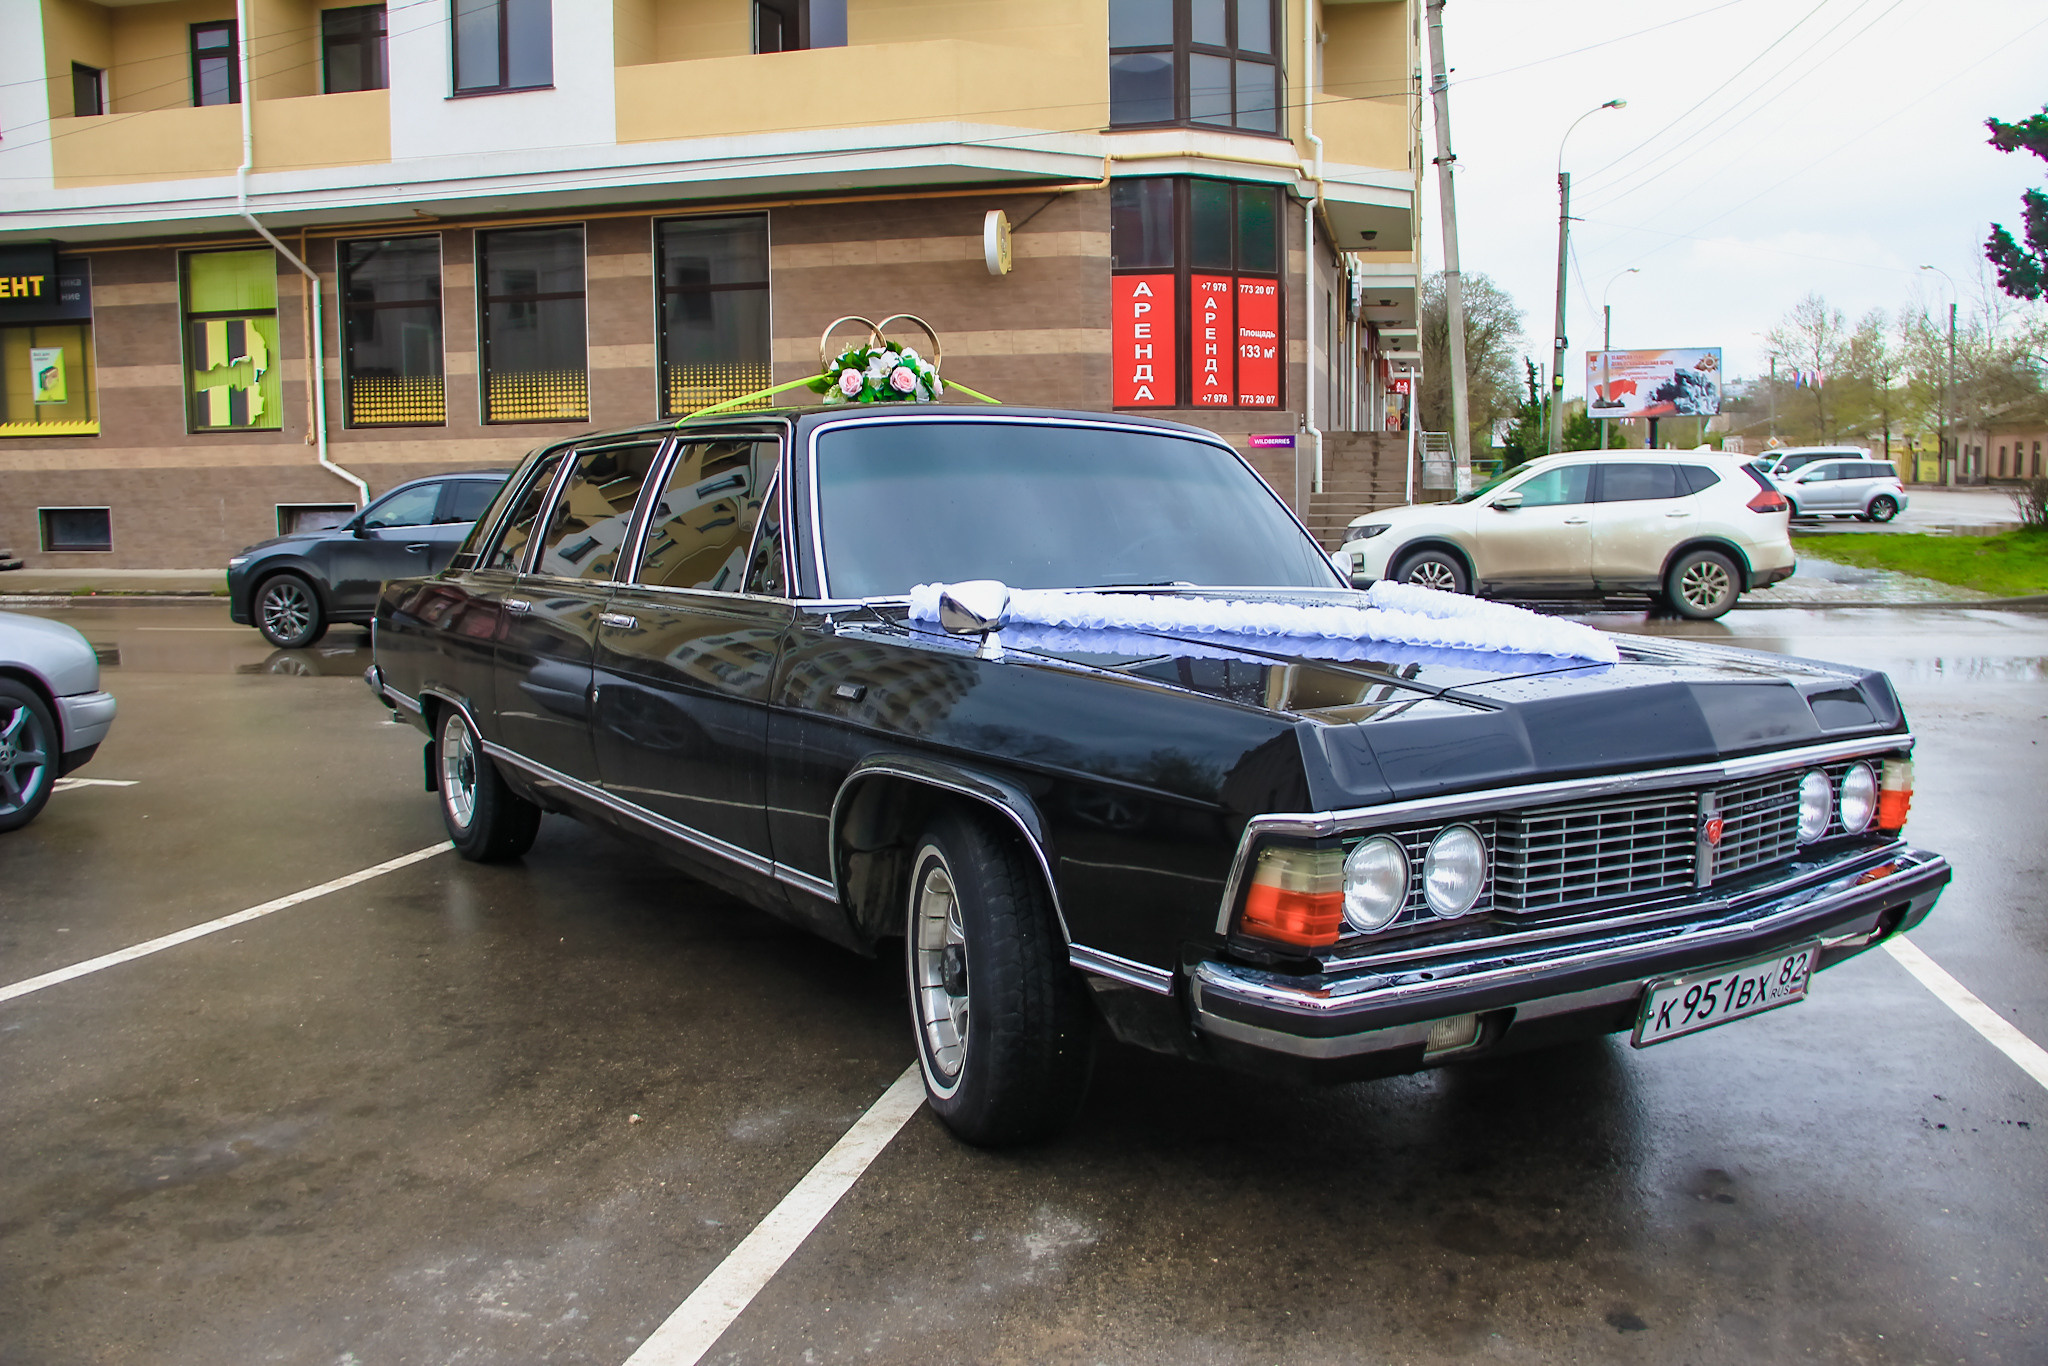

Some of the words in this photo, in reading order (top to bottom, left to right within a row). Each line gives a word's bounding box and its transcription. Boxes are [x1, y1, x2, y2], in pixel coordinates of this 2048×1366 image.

[1201, 282, 1211, 291] +7
[1212, 283, 1227, 292] 978
[1240, 284, 1254, 294] 773
[1255, 286, 1264, 295] 20
[1265, 286, 1275, 295] 07
[1240, 327, 1276, 339] Площадь
[1132, 281, 1155, 401] АРЕНДА
[1204, 297, 1218, 386] АРЕНДА
[1240, 344, 1261, 358] 133
[1202, 394, 1212, 403] +7
[1213, 394, 1228, 403] 978
[1240, 394, 1254, 404] 773
[1255, 395, 1265, 404] 20
[1266, 395, 1276, 404] 07
[1779, 952, 1808, 985] 82
[1770, 984, 1790, 999] RUS
